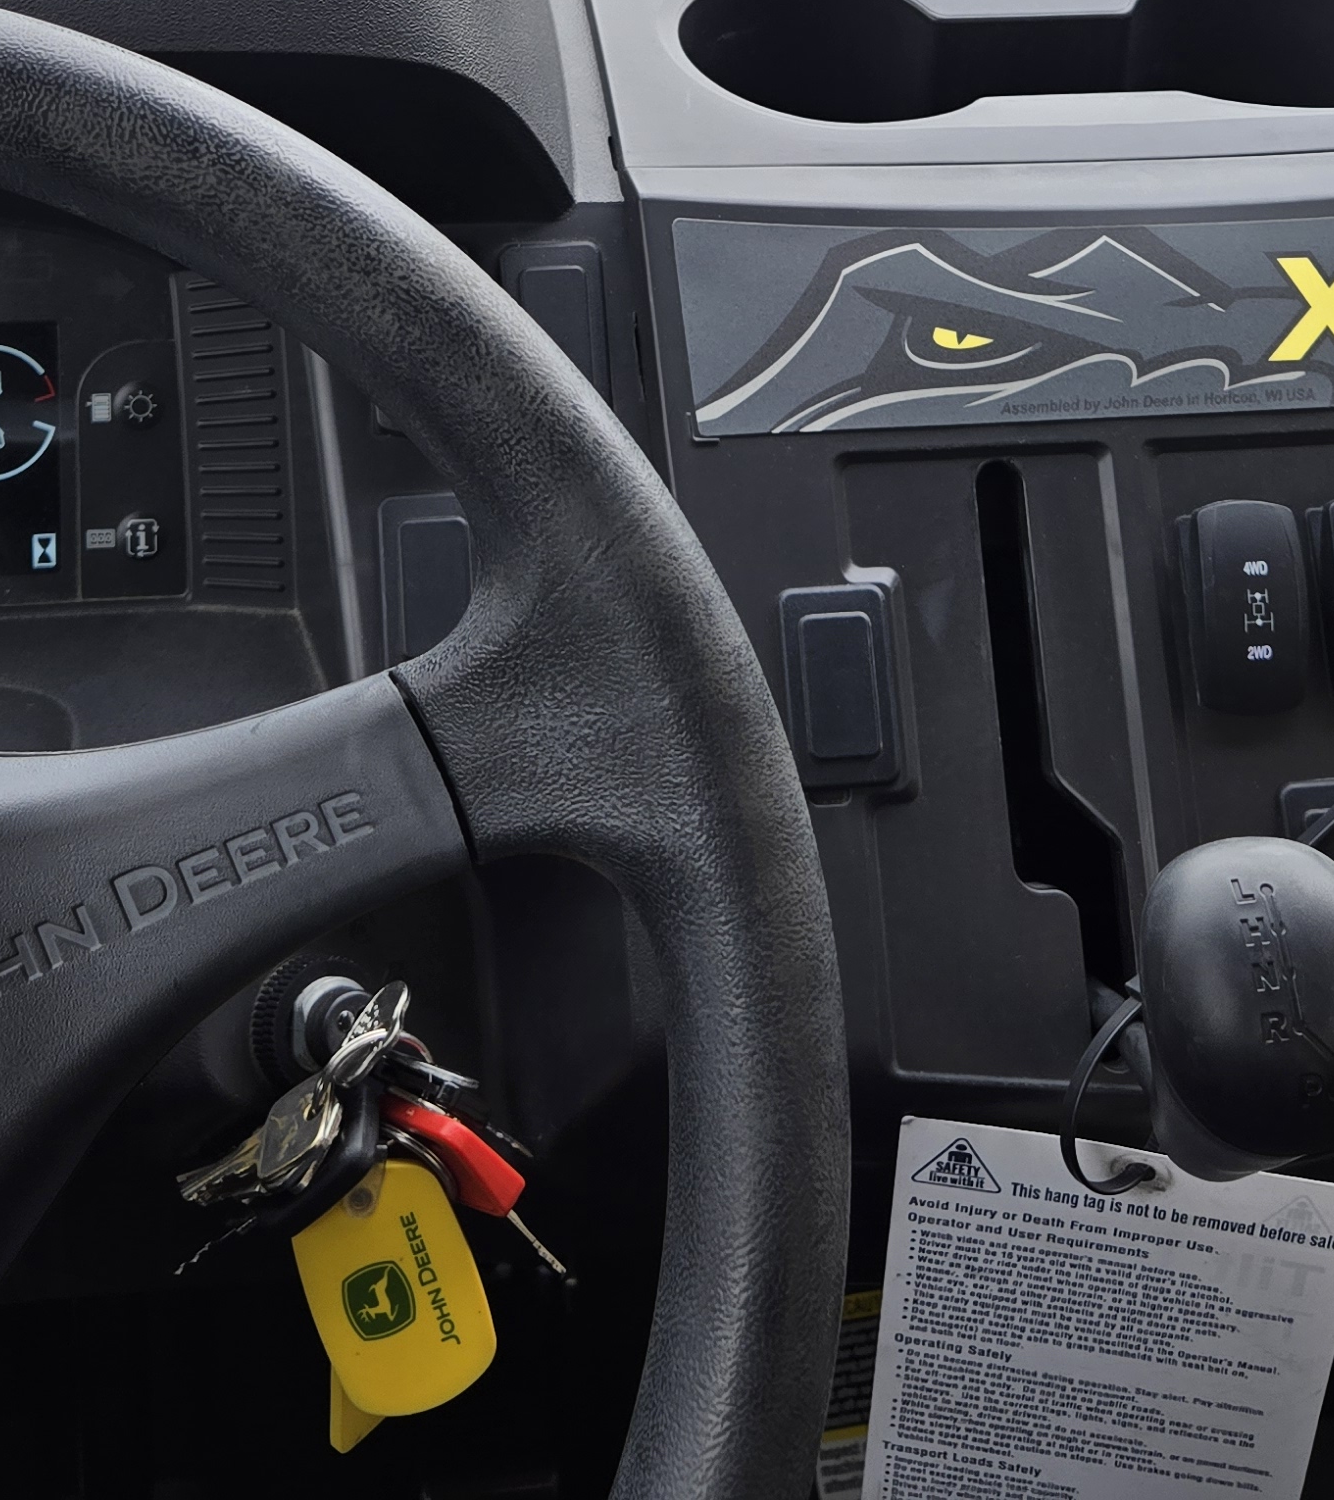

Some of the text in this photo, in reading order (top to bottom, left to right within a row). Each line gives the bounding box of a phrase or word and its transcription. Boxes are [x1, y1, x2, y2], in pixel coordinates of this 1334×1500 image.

[1000, 400, 1080, 416] Assembled
[1083, 399, 1100, 414] by
[1103, 396, 1139, 411] John
[1264, 389, 1283, 402] WI
[1285, 387, 1316, 401] USA
[1243, 561, 1268, 576] 4WD
[1247, 645, 1273, 660] 2WD
[110, 792, 374, 932] DEERE
[1230, 878, 1257, 905] L
[1240, 917, 1270, 947] H
[1251, 961, 1280, 992] N
[1261, 1012, 1290, 1044] R
[928, 1170, 984, 1188] live with it
[935, 1159, 980, 1177] SAFETY
[908, 1195, 1219, 1254] Avoid Injury or Death From Improper Use.
[1009, 1181, 1041, 1200] This
[1043, 1187, 1079, 1209] hang
[1082, 1193, 1105, 1213] tag
[1109, 1197, 1123, 1213] is
[1126, 1201, 1150, 1218] not
[1152, 1205, 1167, 1221] to
[1170, 1208, 1188, 1224] be
[1192, 1213, 1255, 1236] removed
[1259, 1223, 1306, 1245] before
[907, 1211, 1149, 1259] Operator and User Requirements
[919, 1229, 953, 1241] Watch
[955, 1234, 985, 1246] video
[988, 1240, 1007, 1250] and
[1010, 1243, 1035, 1254] read
[1097, 1257, 1137, 1270] manual
[1140, 1264, 1175, 1277] before
[1178, 1272, 1201, 1281] use.
[400, 1211, 461, 1345] JOHN DEERE
[918, 1237, 951, 1250] Driver
[954, 1243, 981, 1254] must
[984, 1248, 997, 1257] be
[1000, 1250, 1013, 1259] 16
[1015, 1253, 1045, 1265] years
[1048, 1258, 1066, 1268] old
[1068, 1261, 1092, 1272] with
[1104, 1267, 1131, 1279] valid
[918, 1246, 949, 1257] Never
[951, 1251, 979, 1263] drive
[982, 1257, 994, 1265] or
[996, 1259, 1017, 1269] ride
[1021, 1263, 1051, 1275] under
[1054, 1268, 1071, 1278] the
[1127, 1280, 1138, 1289] of
[1141, 1282, 1171, 1295] drugs
[1174, 1288, 1186, 1297] or
[915, 1264, 959, 1277] manner,
[962, 1271, 976, 1280] on
[978, 1274, 1009, 1286] rough
[1012, 1279, 1023, 1287] or
[1026, 1282, 1064, 1294] uneven
[1111, 1296, 1122, 1304] or
[1126, 1298, 1136, 1306] at
[1139, 1300, 1174, 1313] higher
[1177, 1307, 1219, 1321] speeds.
[915, 1272, 943, 1283] Wear
[946, 1278, 968, 1289] eye,
[972, 1282, 993, 1292] ear,
[997, 1285, 1016, 1295] and
[1019, 1289, 1047, 1300] other
[1166, 1315, 1179, 1323] as
[916, 1254, 945, 1266] Wear
[948, 1261, 961, 1269] an
[1016, 1271, 1052, 1283] helmet
[1055, 1277, 1084, 1289] when
[1141, 1292, 1159, 1301] the
[1161, 1295, 1201, 1309] vehicle
[1204, 1302, 1215, 1310] in
[1217, 1305, 1231, 1313] an
[893, 1332, 1012, 1363] Operating Safely
[881, 1440, 1041, 1478] Transport Loads Safely
